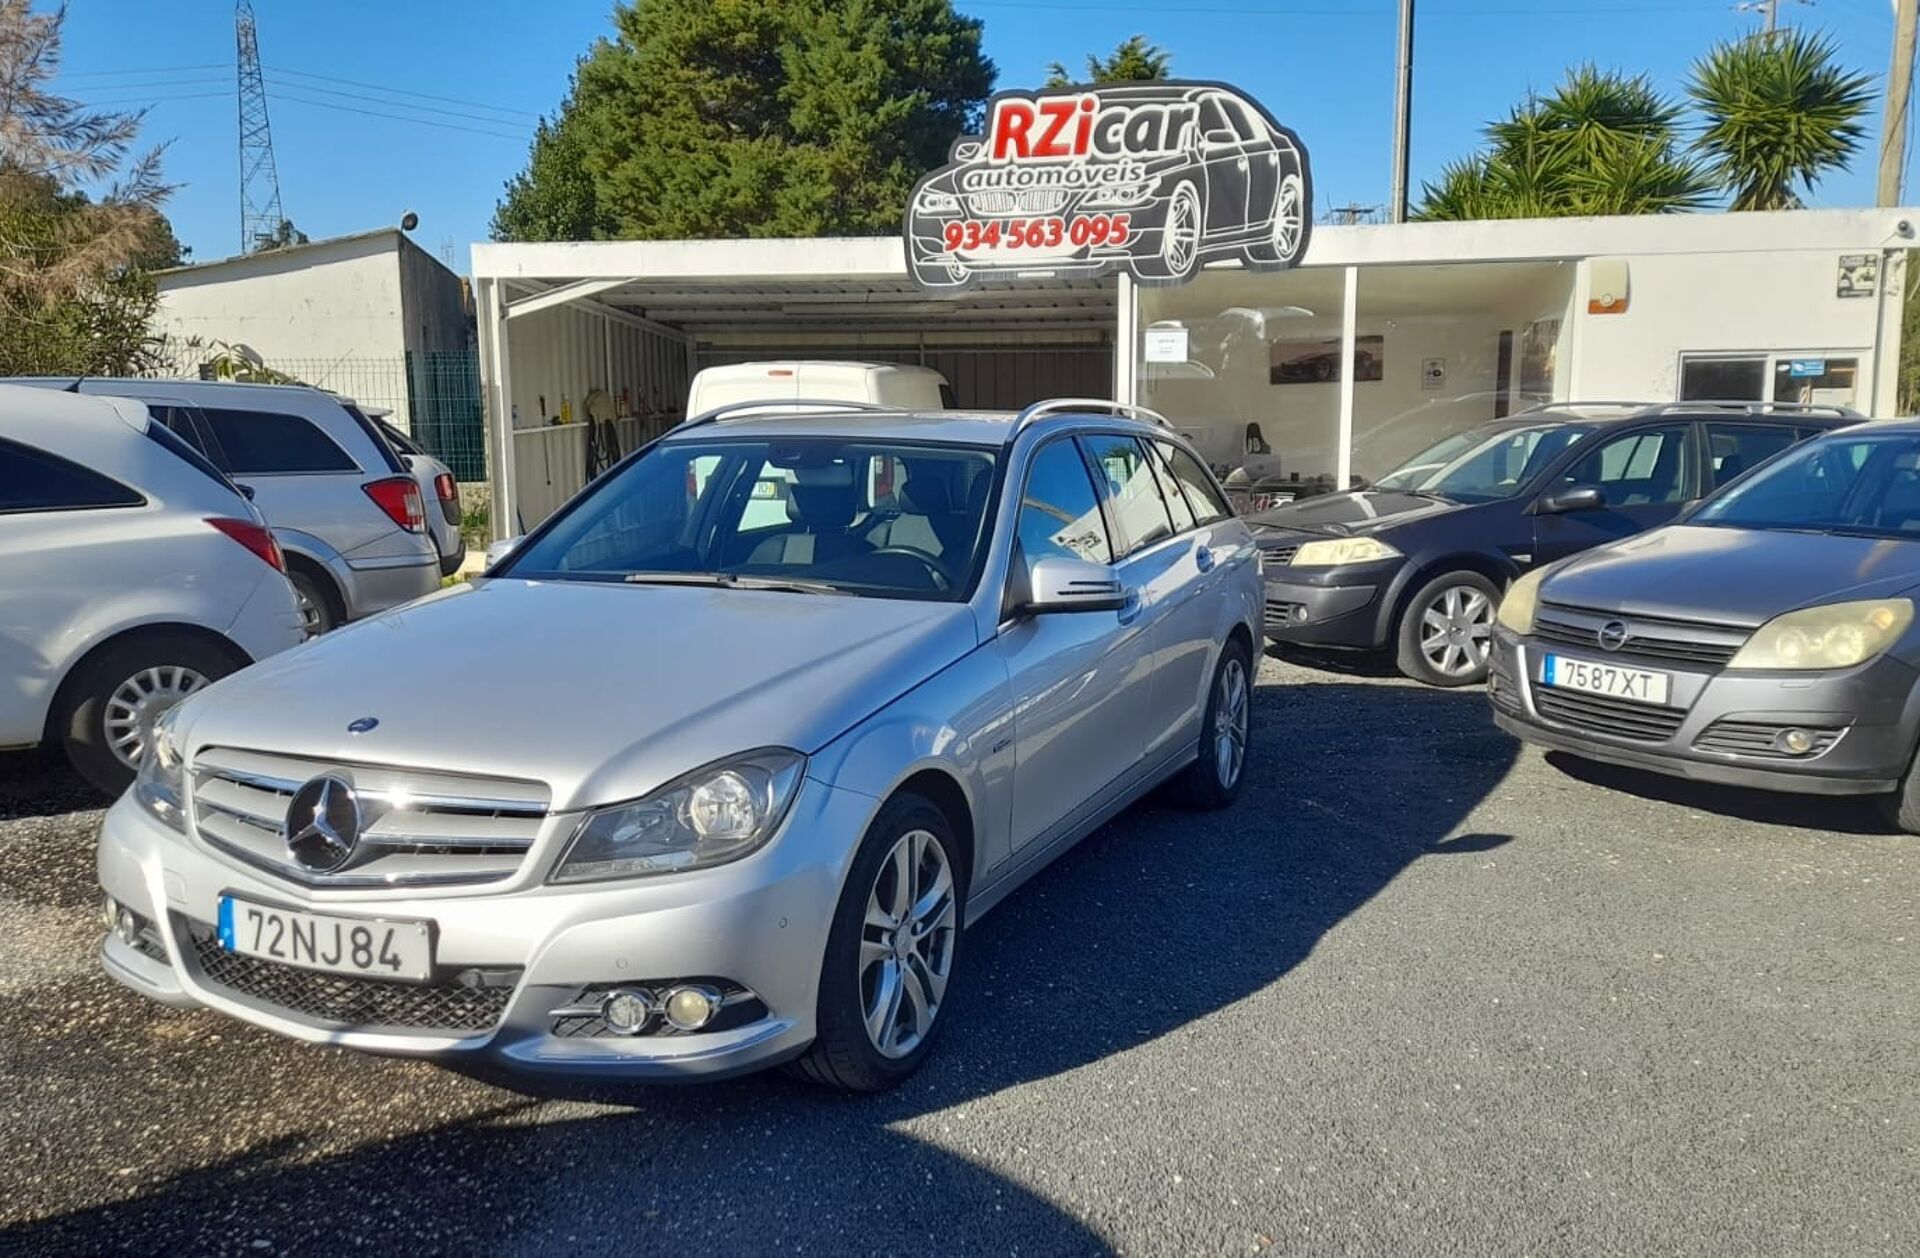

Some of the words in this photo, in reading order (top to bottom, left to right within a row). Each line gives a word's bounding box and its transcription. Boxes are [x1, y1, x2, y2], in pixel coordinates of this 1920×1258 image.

[993, 98, 1195, 160] RZicar
[967, 162, 1142, 188] automóveis
[945, 220, 1000, 250] 934
[1007, 217, 1063, 248] 563
[1070, 214, 1130, 246] 095
